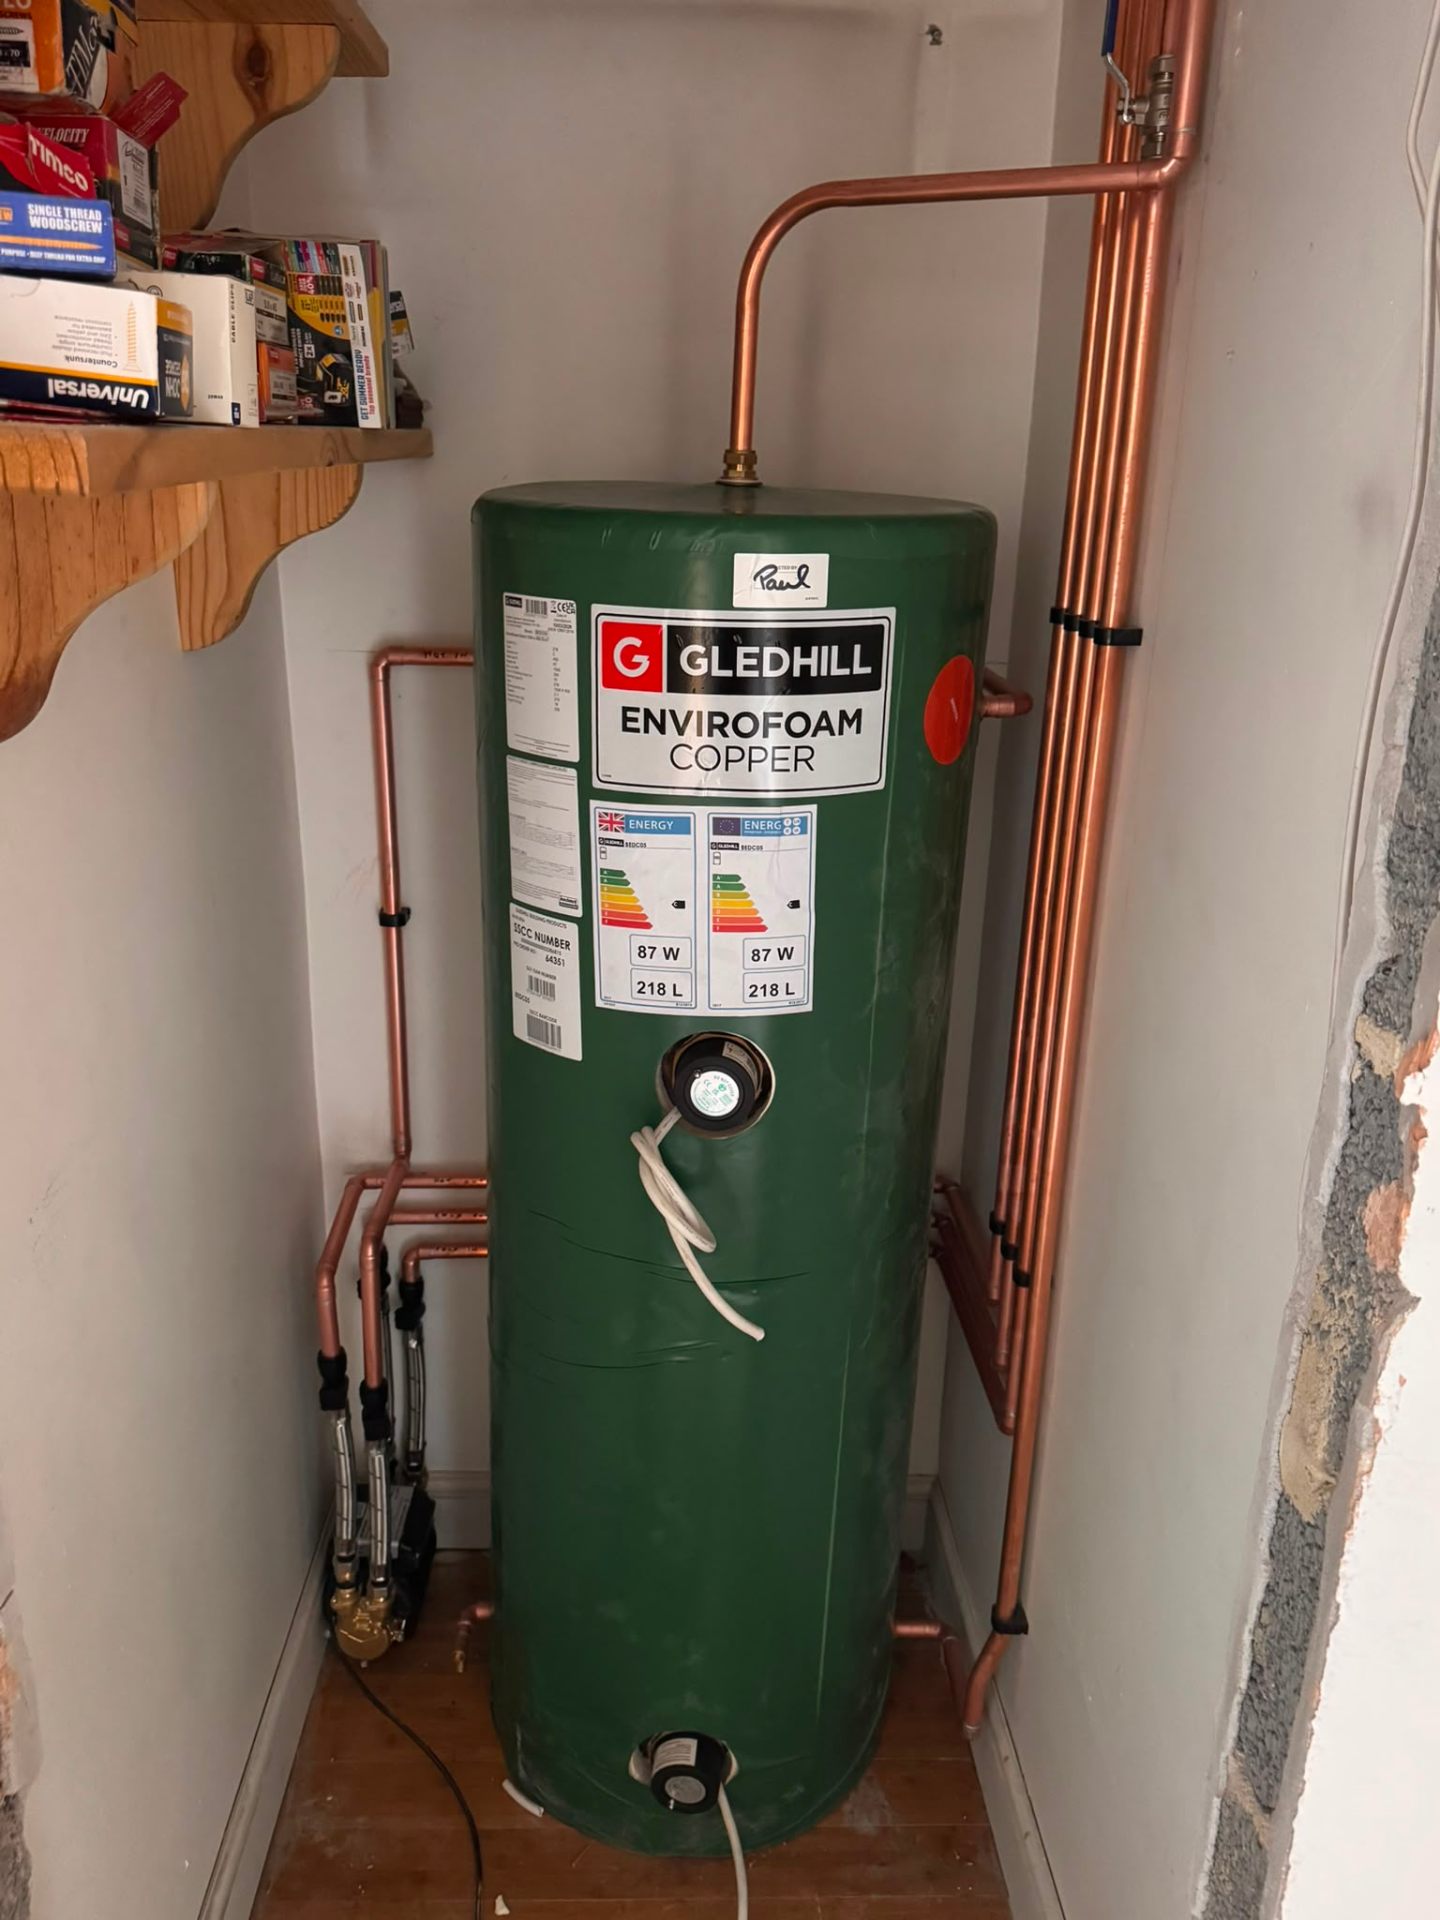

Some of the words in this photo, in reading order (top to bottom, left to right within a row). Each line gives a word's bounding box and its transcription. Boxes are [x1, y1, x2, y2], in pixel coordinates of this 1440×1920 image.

[27, 202, 63, 217] SINGLE
[63, 205, 103, 221] THREAD
[28, 215, 103, 235] WOODSCREW
[64, 354, 118, 369] Countersunk
[354, 349, 366, 374] READY
[363, 355, 372, 376] brands
[47, 377, 150, 410] Universal
[356, 374, 368, 406] SUMMER
[359, 406, 369, 421] GET
[753, 563, 812, 591] Paul
[613, 636, 650, 677] G
[679, 644, 872, 678] GLEDHILL
[621, 707, 863, 738] ENVIROFOAM
[669, 743, 815, 774] COPPER
[629, 819, 674, 831] ENERGY
[744, 819, 782, 831] ENERG
[513, 922, 533, 939] SSCC
[533, 931, 571, 951] NUMBER
[545, 954, 565, 968] 64351
[637, 945, 657, 960] 87
[663, 946, 680, 961] W
[751, 948, 771, 962] 87
[777, 946, 795, 960] W
[636, 980, 666, 996] 218
[672, 983, 683, 997] L
[748, 983, 779, 998] 218
[785, 982, 795, 996] L
